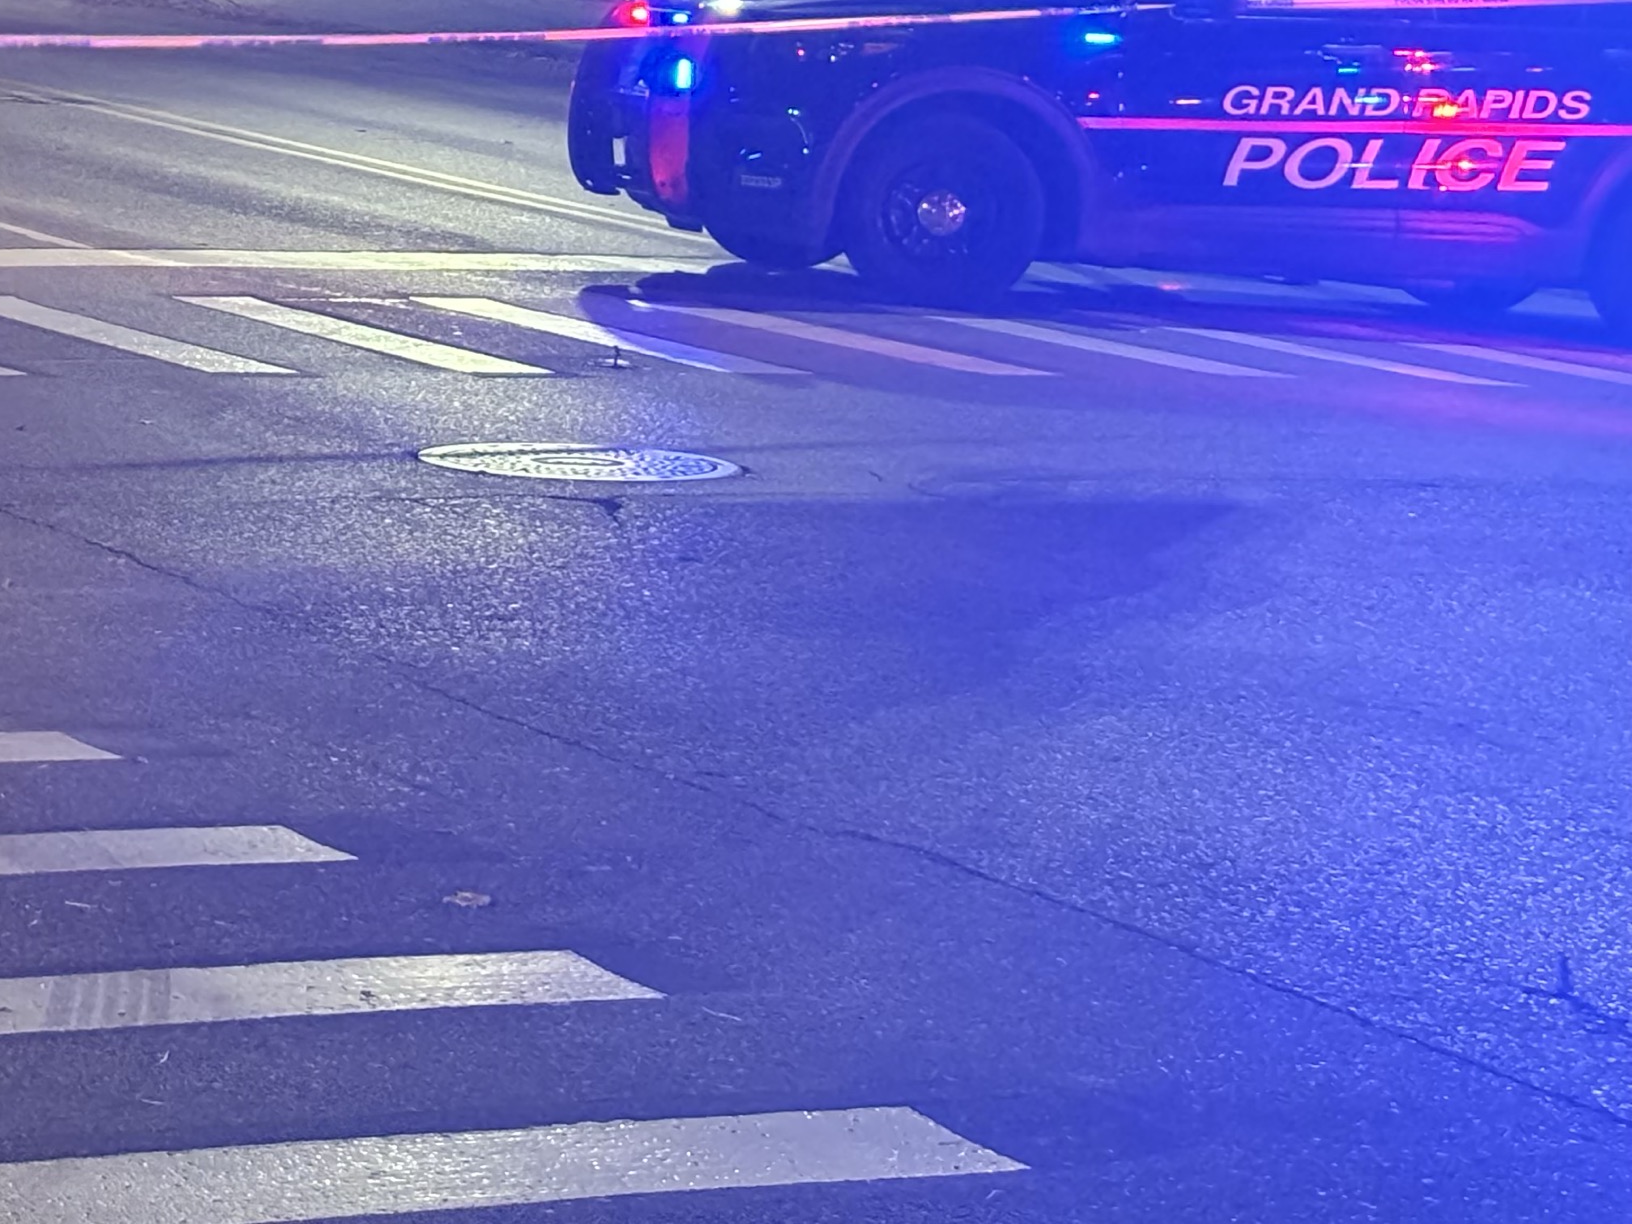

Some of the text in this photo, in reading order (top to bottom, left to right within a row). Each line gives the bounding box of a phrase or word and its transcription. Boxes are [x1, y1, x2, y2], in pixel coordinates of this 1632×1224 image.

[1222, 85, 1592, 120] GRAND RAPIDS
[1222, 137, 1566, 191] POLICE
